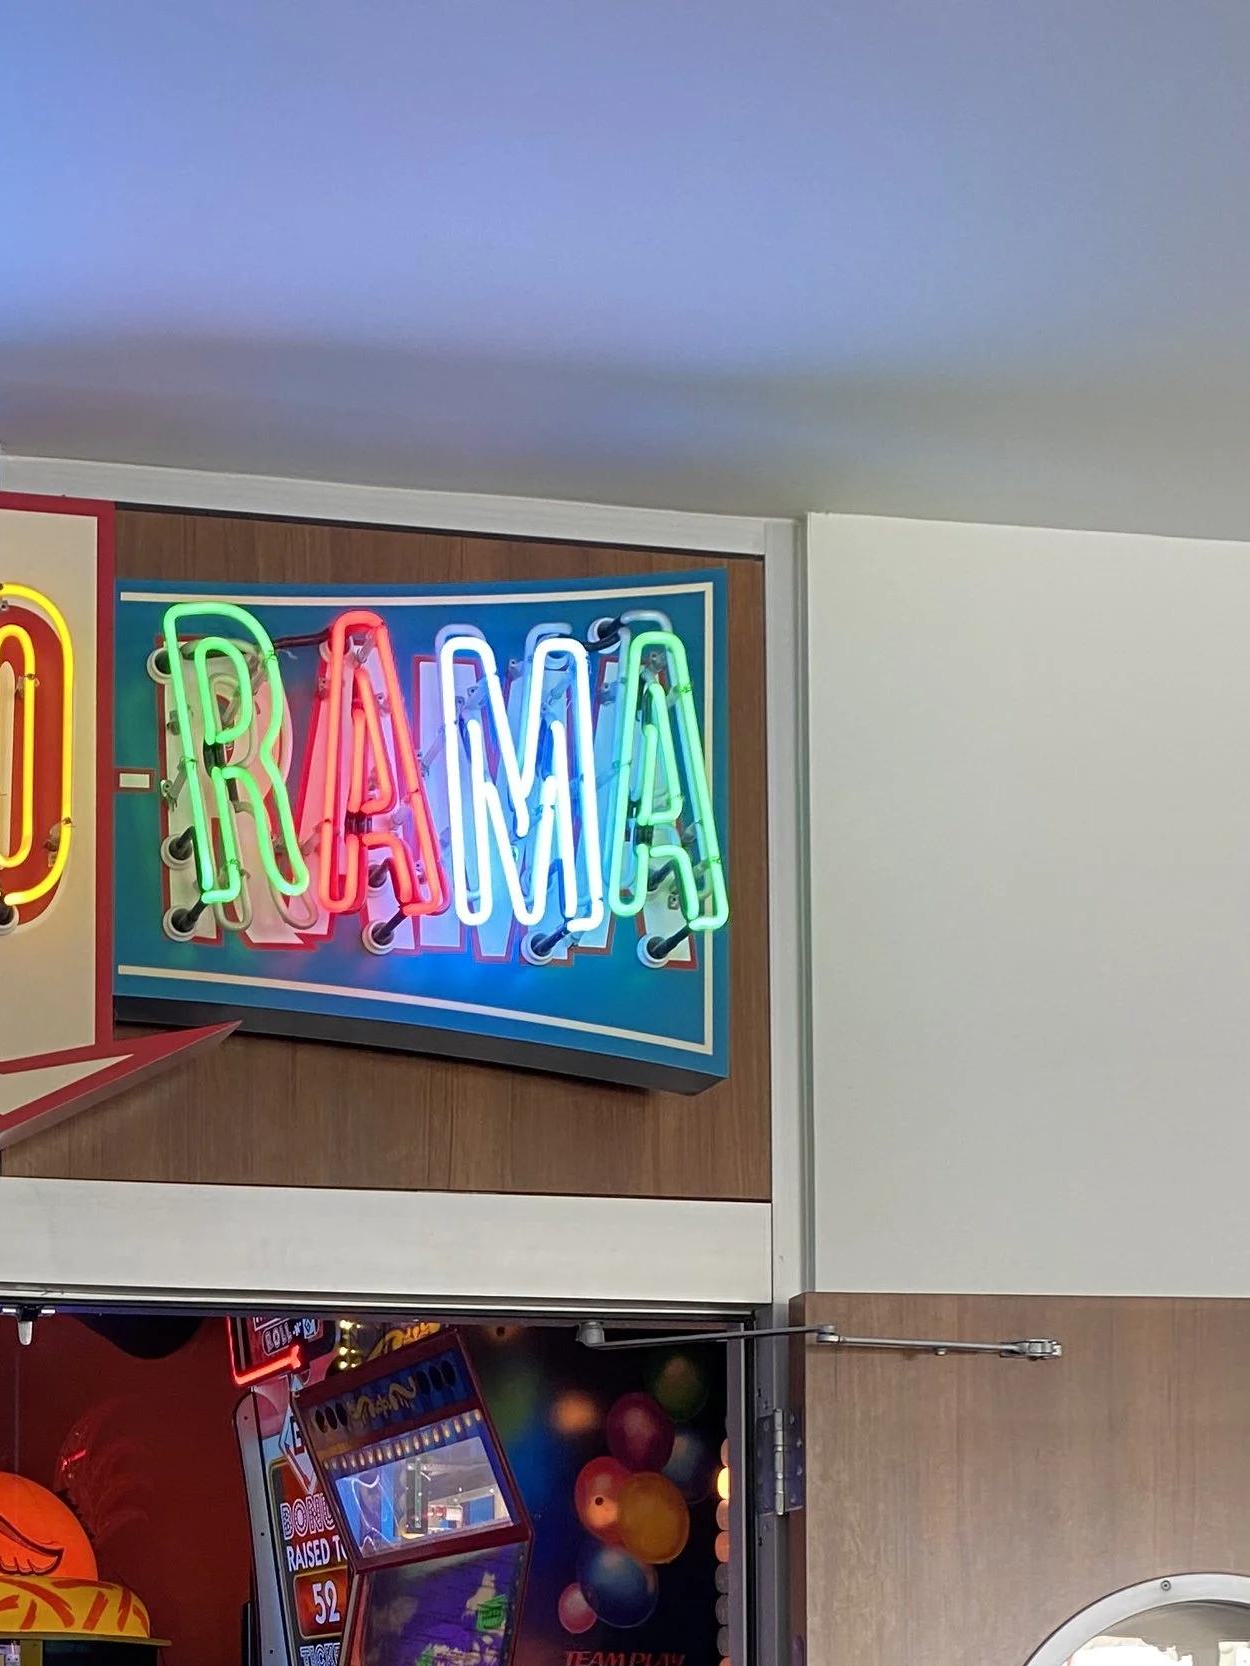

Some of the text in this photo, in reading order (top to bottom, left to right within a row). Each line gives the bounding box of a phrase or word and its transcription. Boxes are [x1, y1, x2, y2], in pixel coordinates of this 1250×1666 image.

[280, 1492, 336, 1541] BONU
[286, 1538, 331, 1572] RAISED
[312, 1582, 340, 1625] 52
